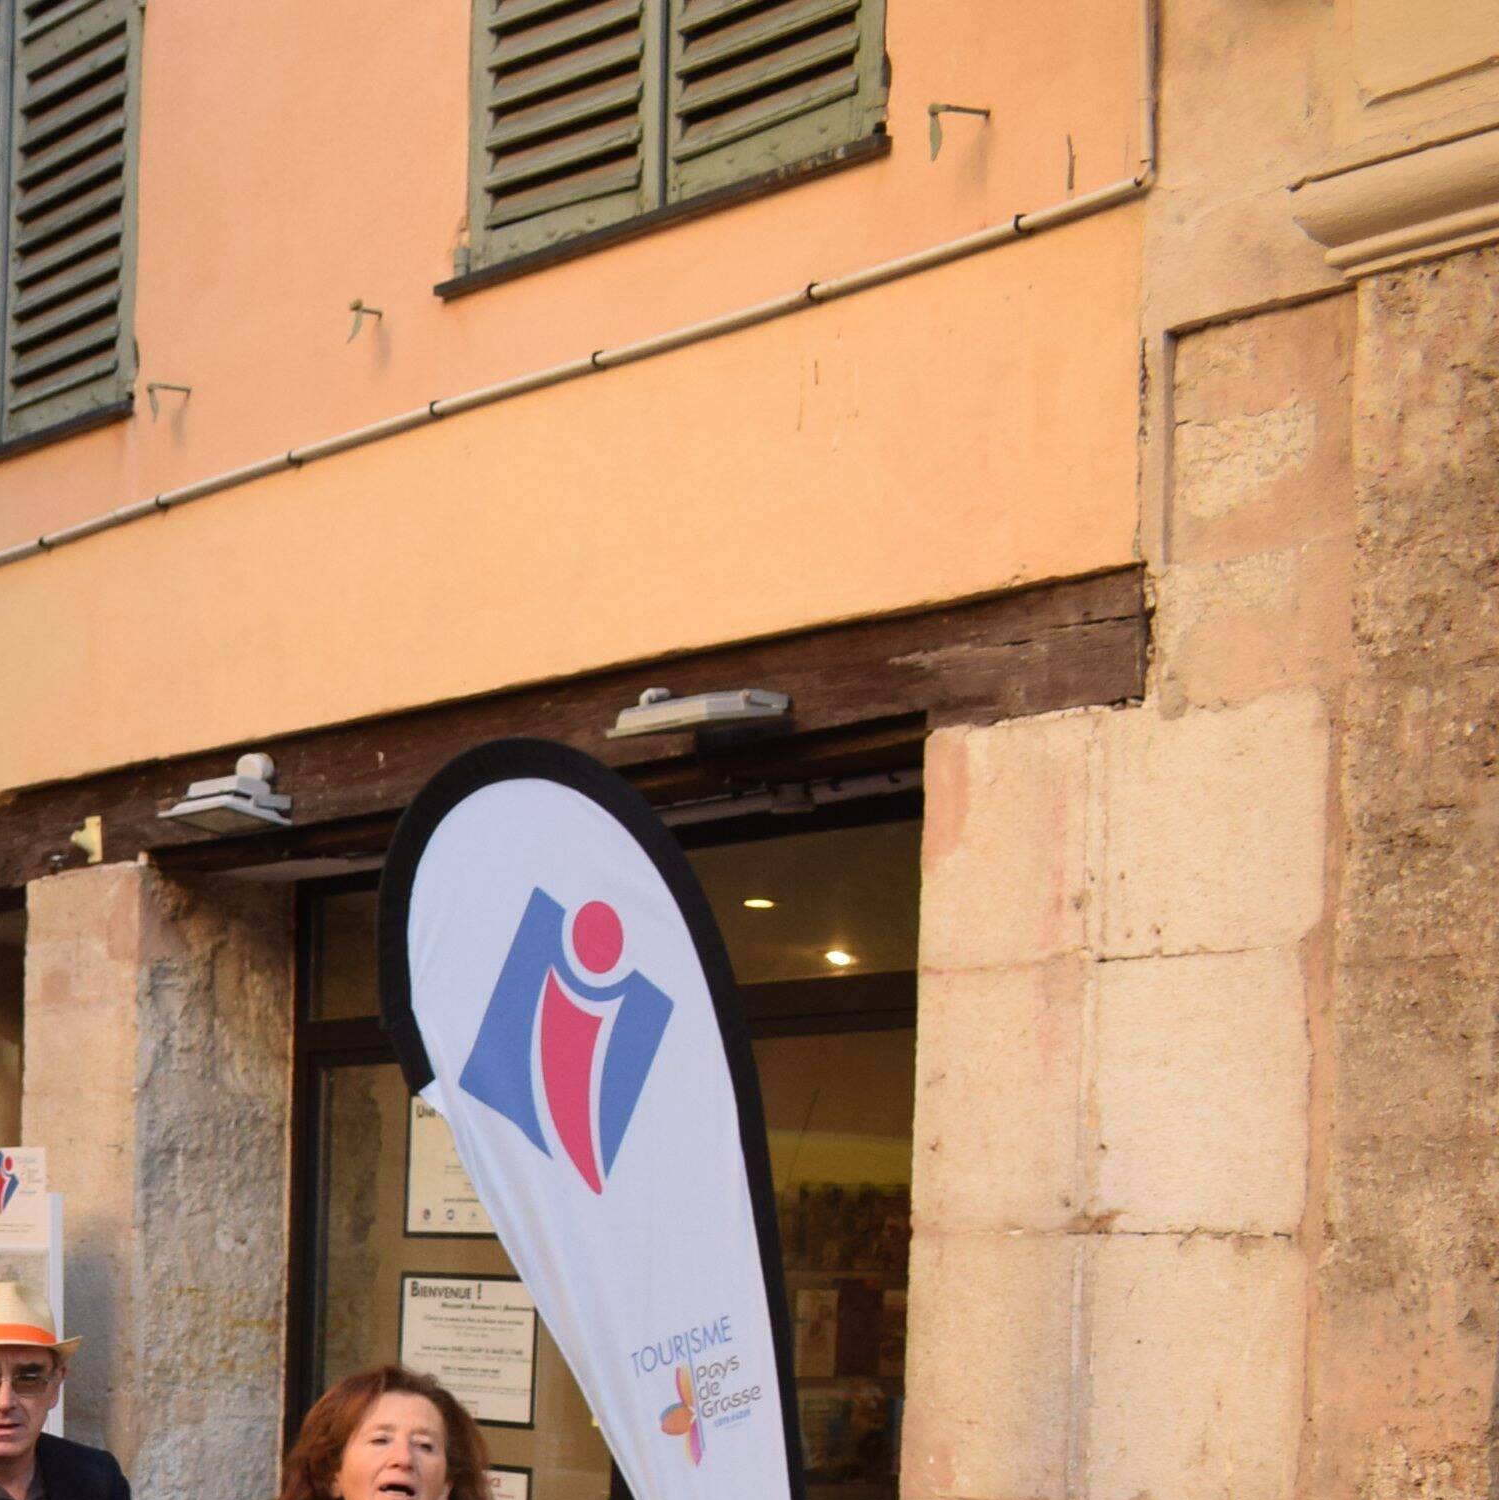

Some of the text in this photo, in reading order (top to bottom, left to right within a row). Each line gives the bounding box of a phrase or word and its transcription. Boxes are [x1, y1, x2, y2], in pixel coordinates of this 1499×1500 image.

[631, 1315, 733, 1378] TOURISME
[698, 1380, 721, 1401] de
[701, 1385, 763, 1419] Grasse
